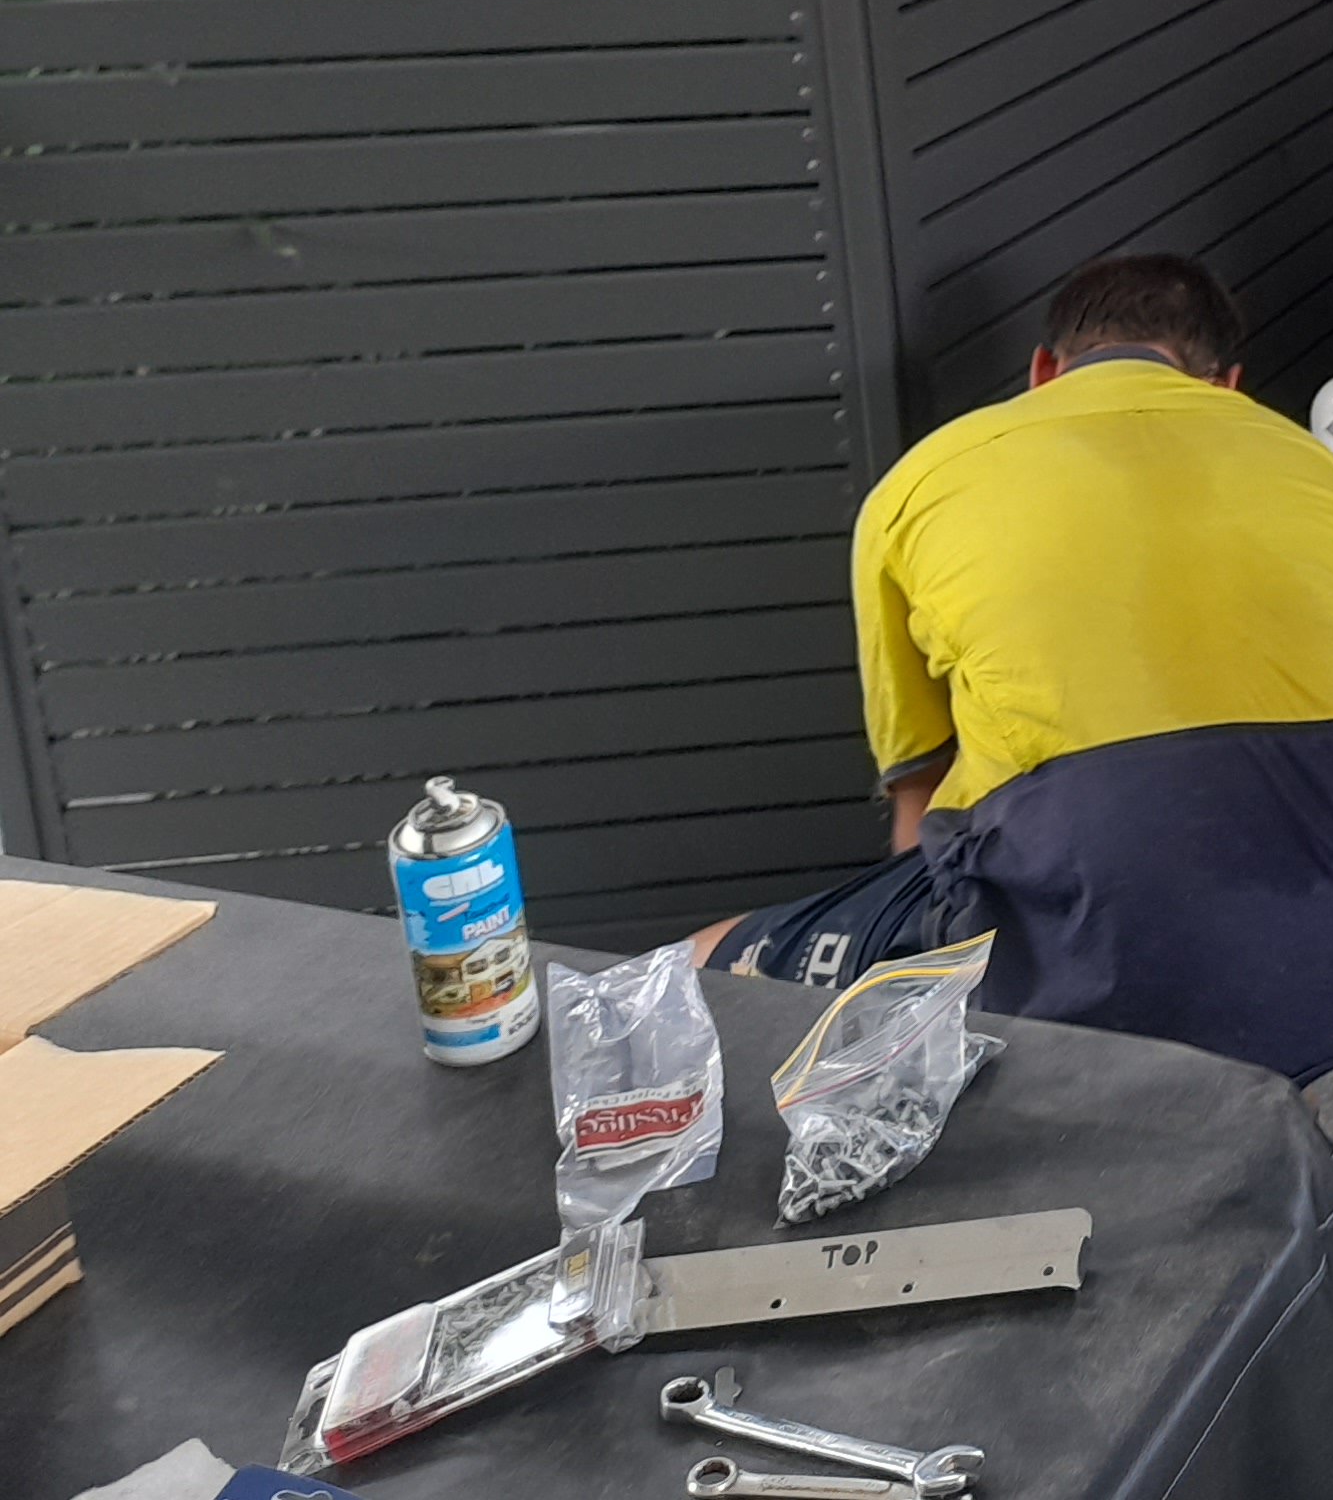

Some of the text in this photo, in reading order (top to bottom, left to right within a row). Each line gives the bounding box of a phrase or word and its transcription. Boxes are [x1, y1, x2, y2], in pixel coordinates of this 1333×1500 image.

[461, 904, 510, 942] PAINT
[579, 1100, 702, 1138] Prestige
[821, 1240, 879, 1269] TOP
